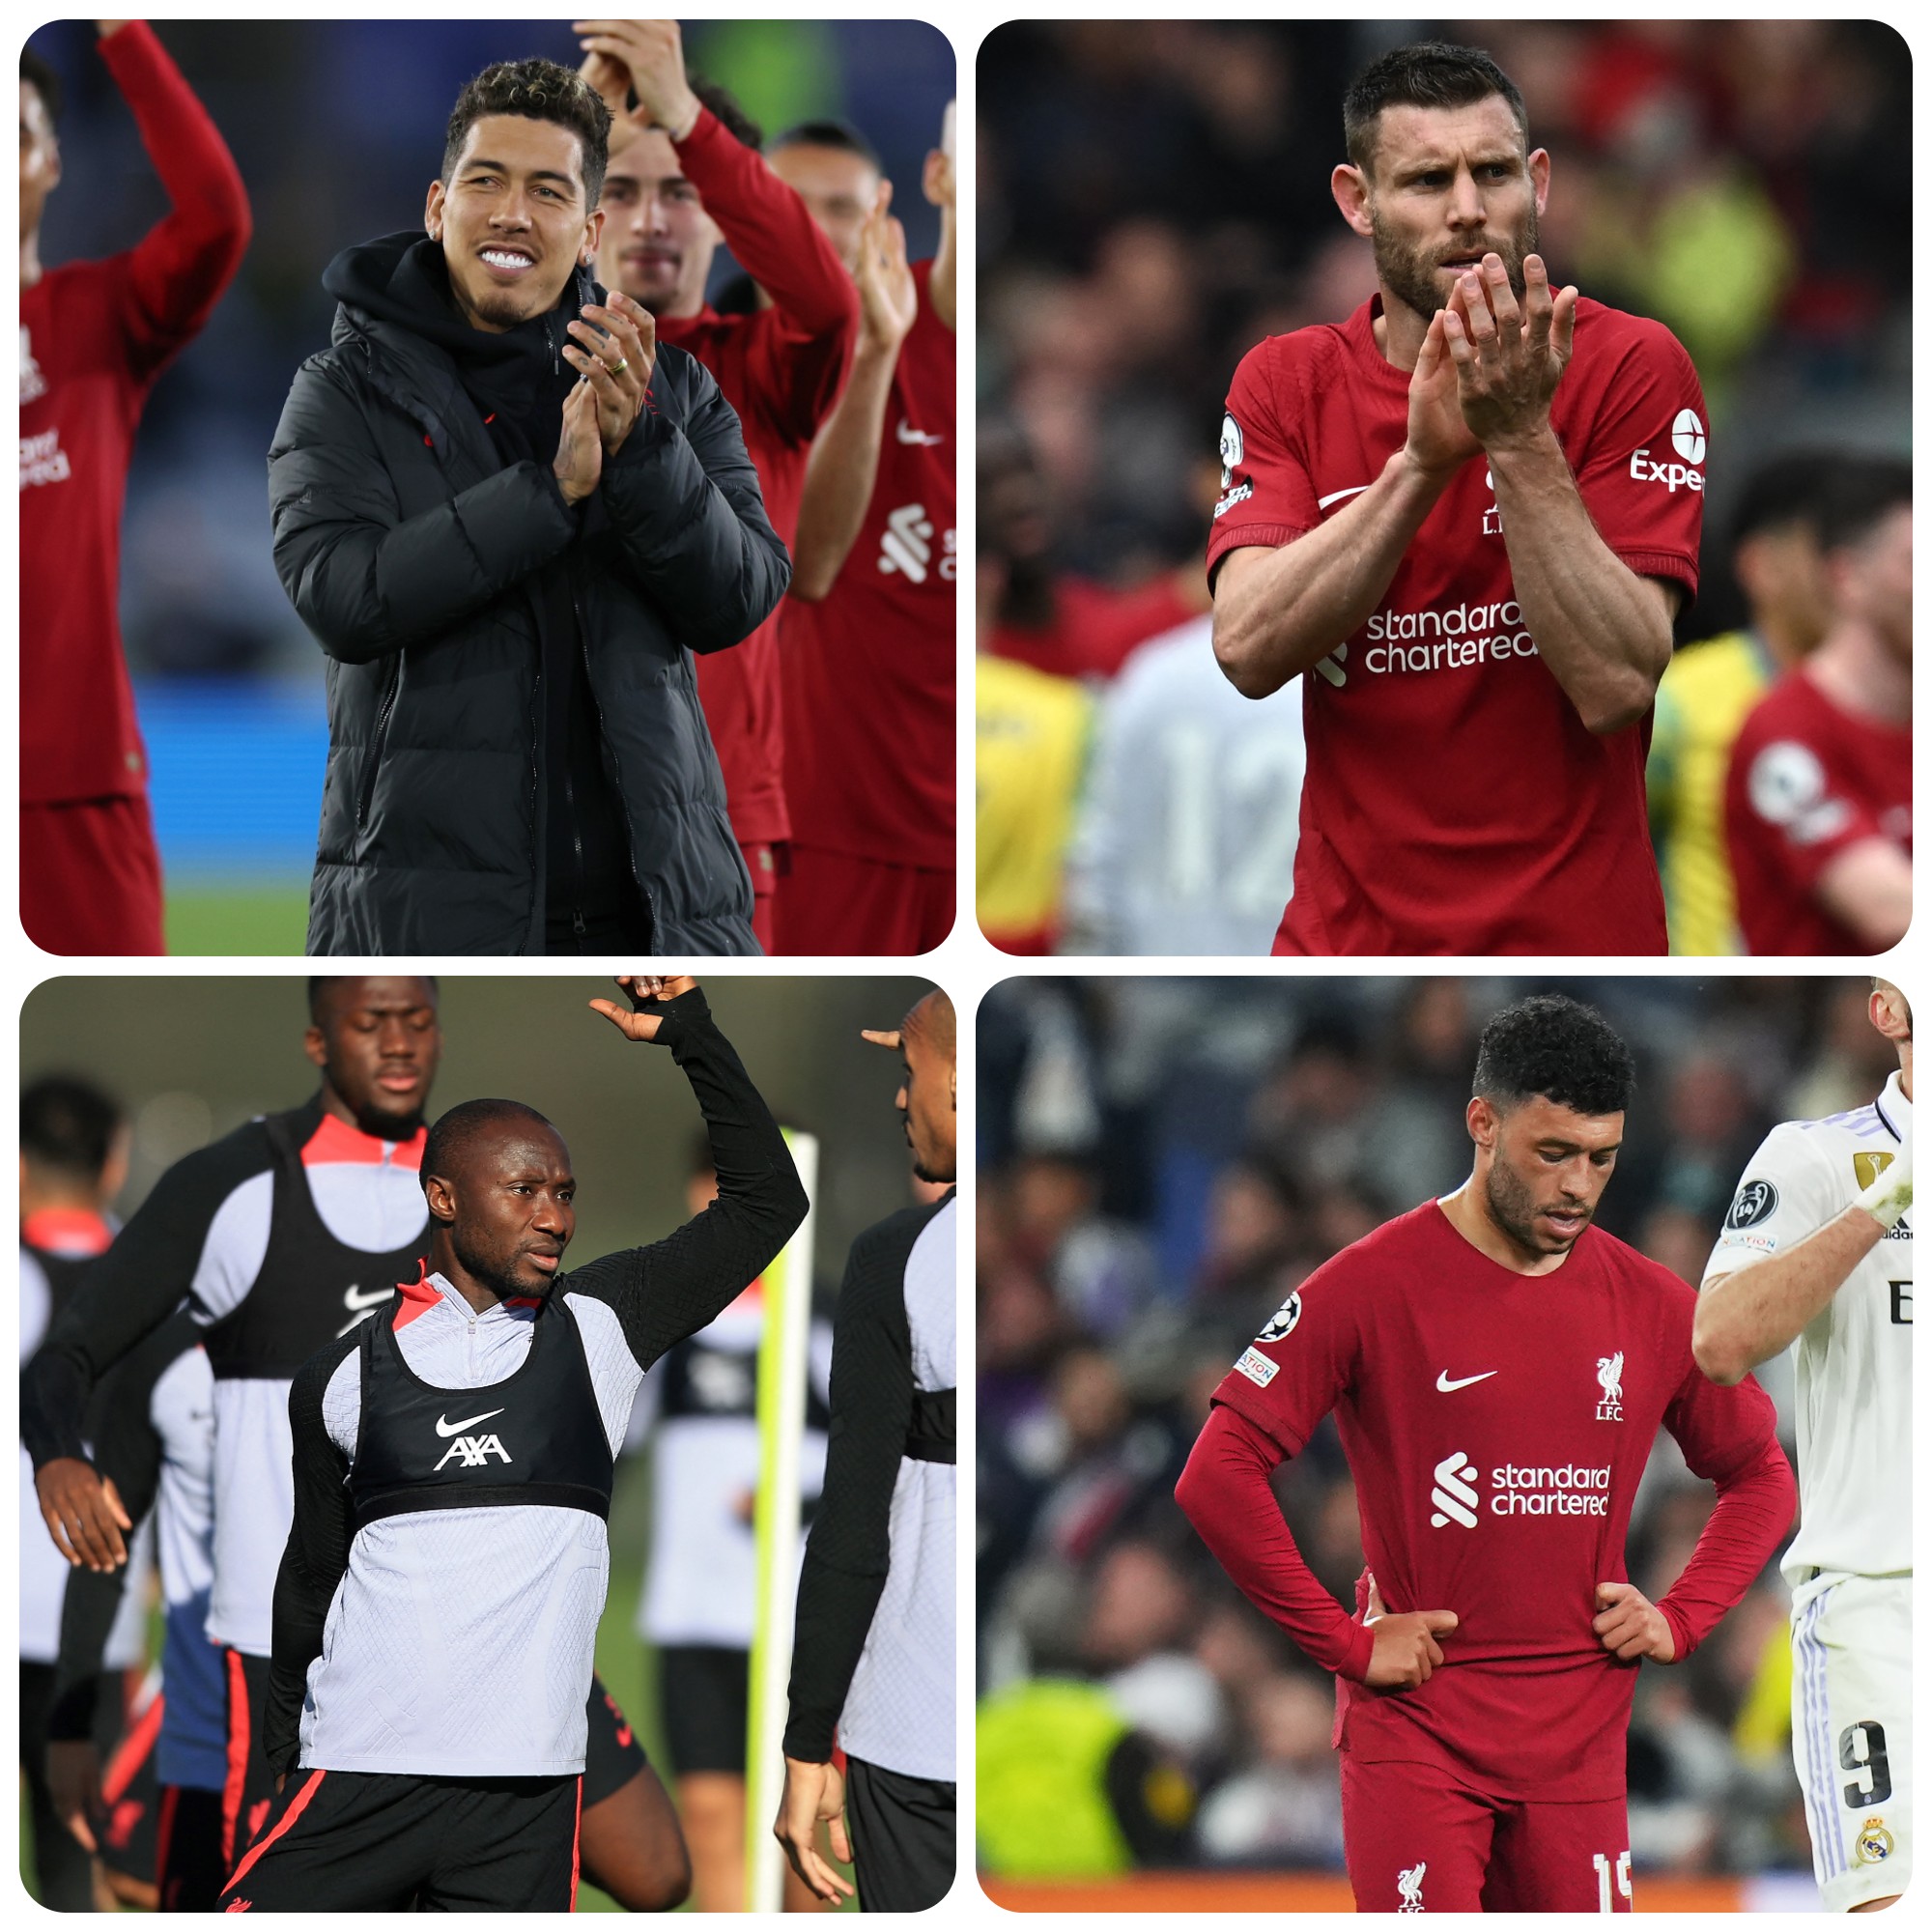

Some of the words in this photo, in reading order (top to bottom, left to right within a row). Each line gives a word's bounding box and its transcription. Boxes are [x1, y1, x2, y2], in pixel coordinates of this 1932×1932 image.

[1630, 449, 1705, 498] Expe
[433, 1435, 513, 1471] AXA
[1492, 1463, 1610, 1489] standard
[1491, 1490, 1609, 1517] chartered
[1838, 1719, 1892, 1809] 9
